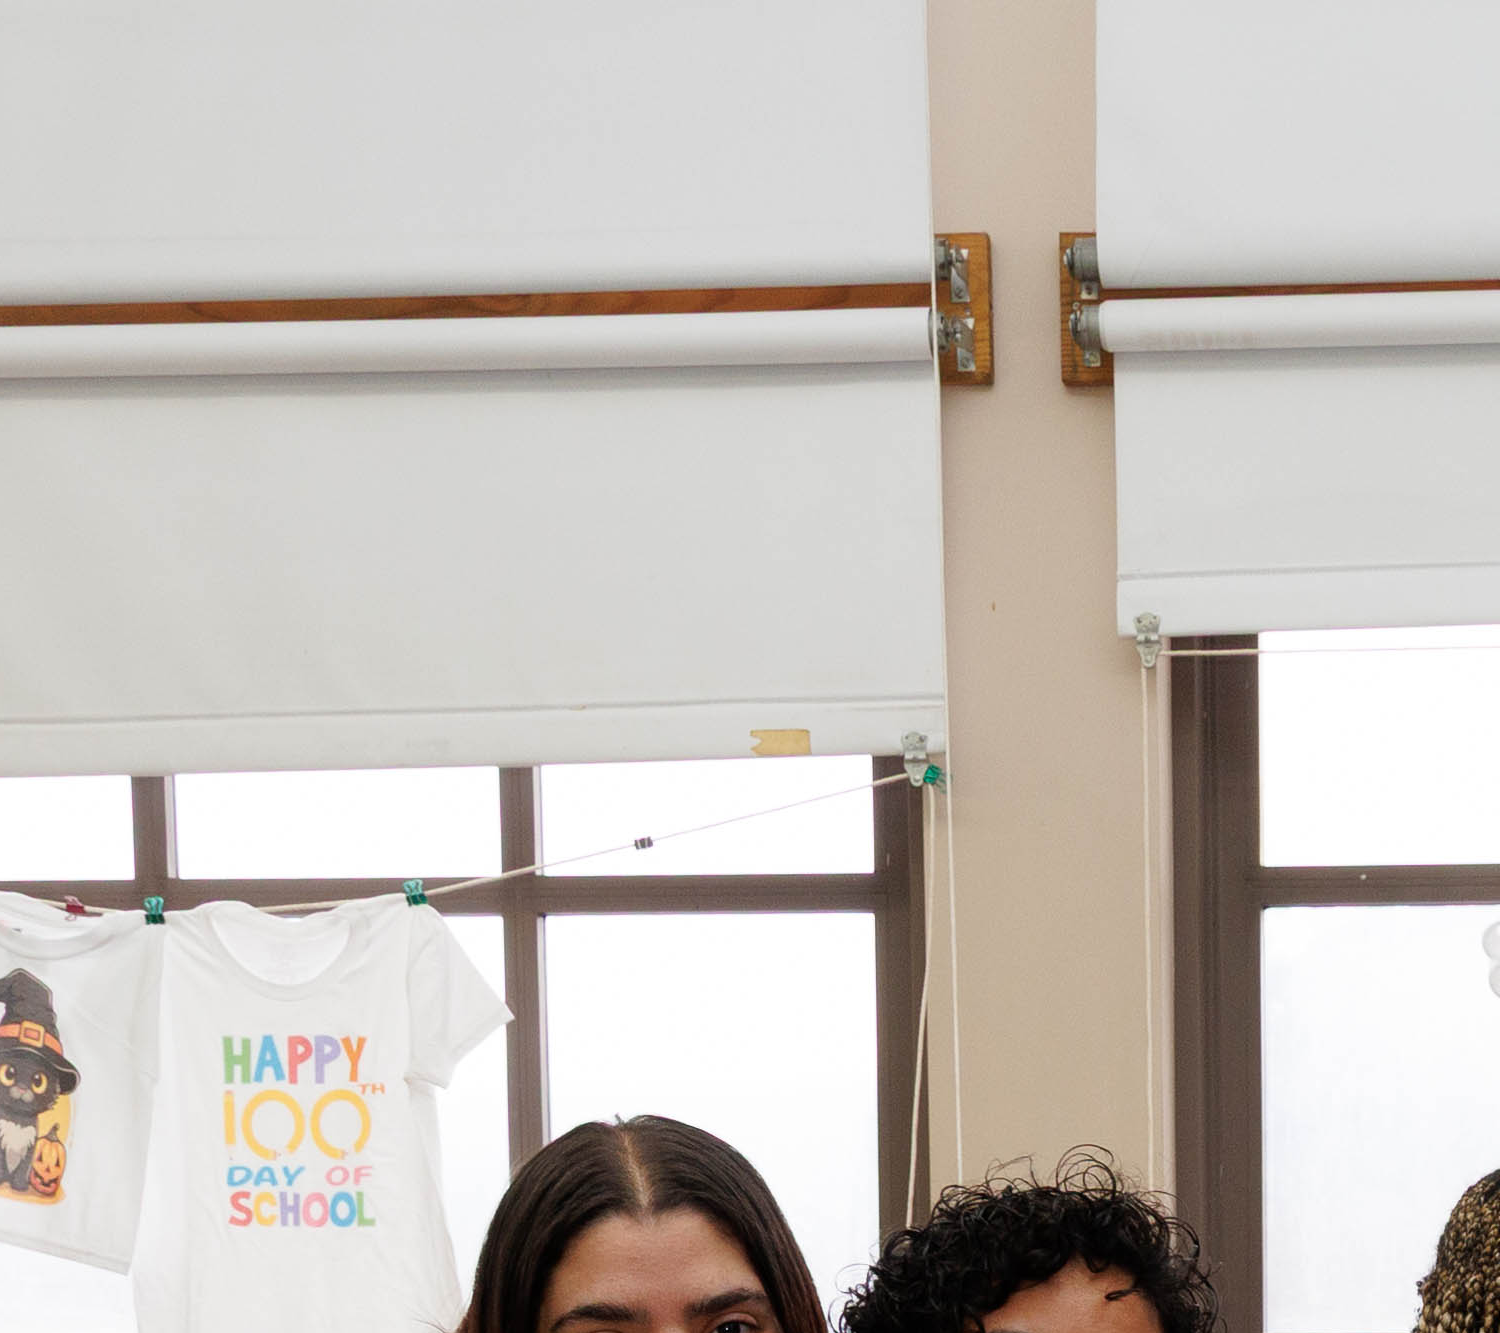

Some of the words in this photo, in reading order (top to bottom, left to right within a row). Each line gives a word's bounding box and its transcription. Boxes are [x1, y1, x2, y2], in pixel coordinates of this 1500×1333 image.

[222, 1035, 367, 1085] HAPPY
[227, 1165, 305, 1187] DAY
[325, 1165, 373, 1187] OF
[228, 1191, 376, 1228] SCHOOL
